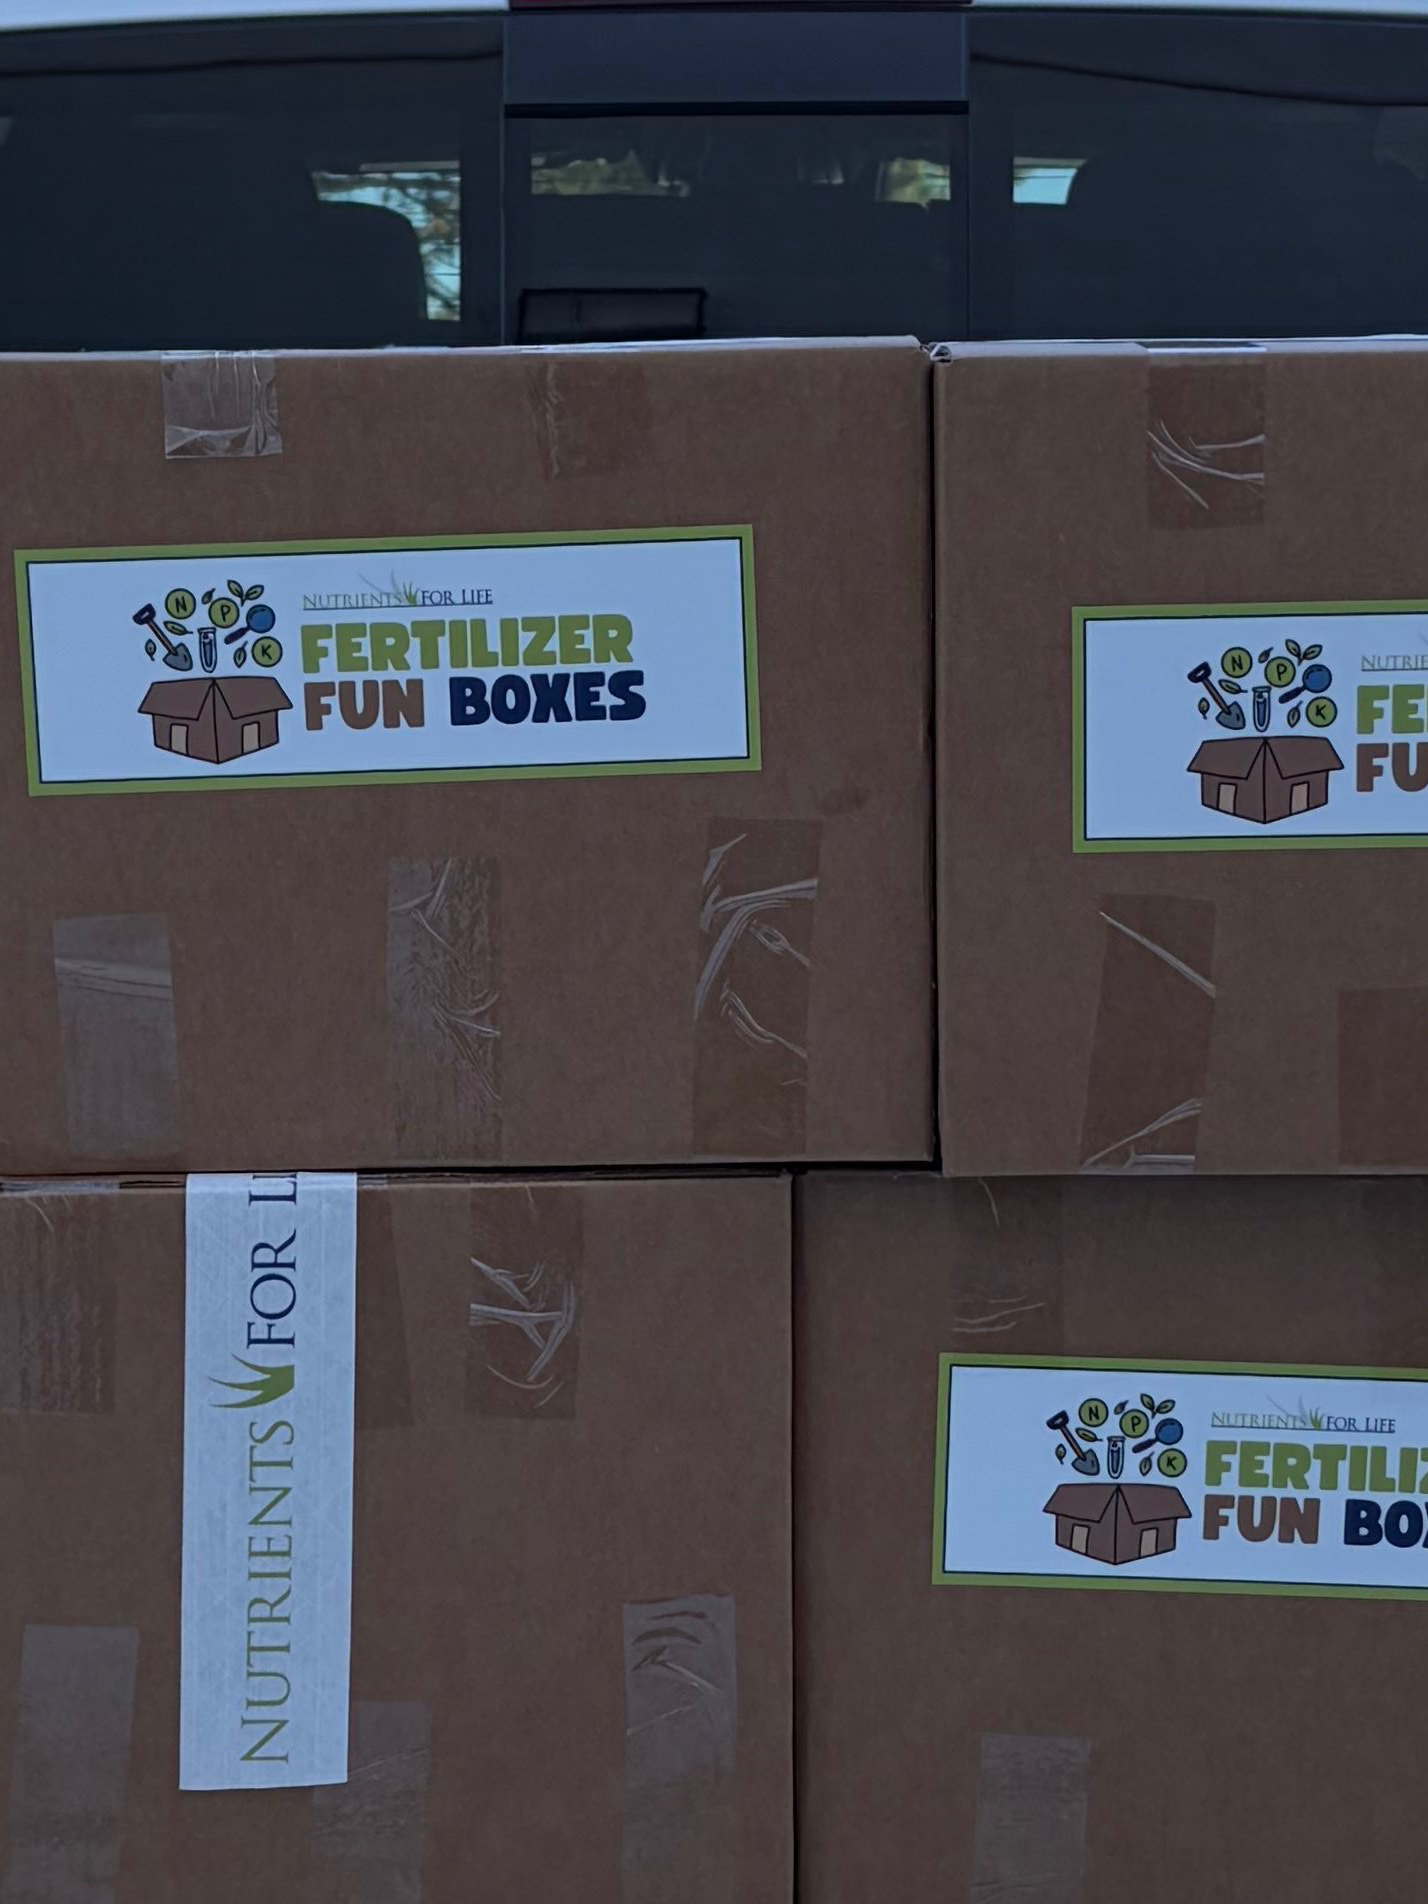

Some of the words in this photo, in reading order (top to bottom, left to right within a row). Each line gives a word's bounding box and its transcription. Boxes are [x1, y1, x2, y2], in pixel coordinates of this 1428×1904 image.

[175, 596, 187, 612] N
[302, 591, 403, 609] NUTRIENTS
[421, 590, 453, 606] FOR
[462, 589, 493, 605] LIFE
[221, 604, 230, 622] P
[261, 644, 272, 659] K
[301, 614, 633, 673] FERTILIZER
[1231, 656, 1243, 671] N
[1276, 663, 1288, 681] P
[304, 679, 424, 730] FUN
[449, 670, 646, 726] BOXES
[1315, 704, 1326, 720] K
[245, 1228, 297, 1350] FOR
[1088, 1405, 1099, 1421] N
[1211, 1411, 1308, 1428] NUTRIENTS
[1326, 1415, 1359, 1432] FOR
[1365, 1417, 1396, 1433] LIFE
[1130, 1415, 1141, 1432] P
[1166, 1456, 1177, 1471] K
[1203, 1494, 1320, 1544] FUN
[239, 1418, 295, 1766] NUTRIENTS
